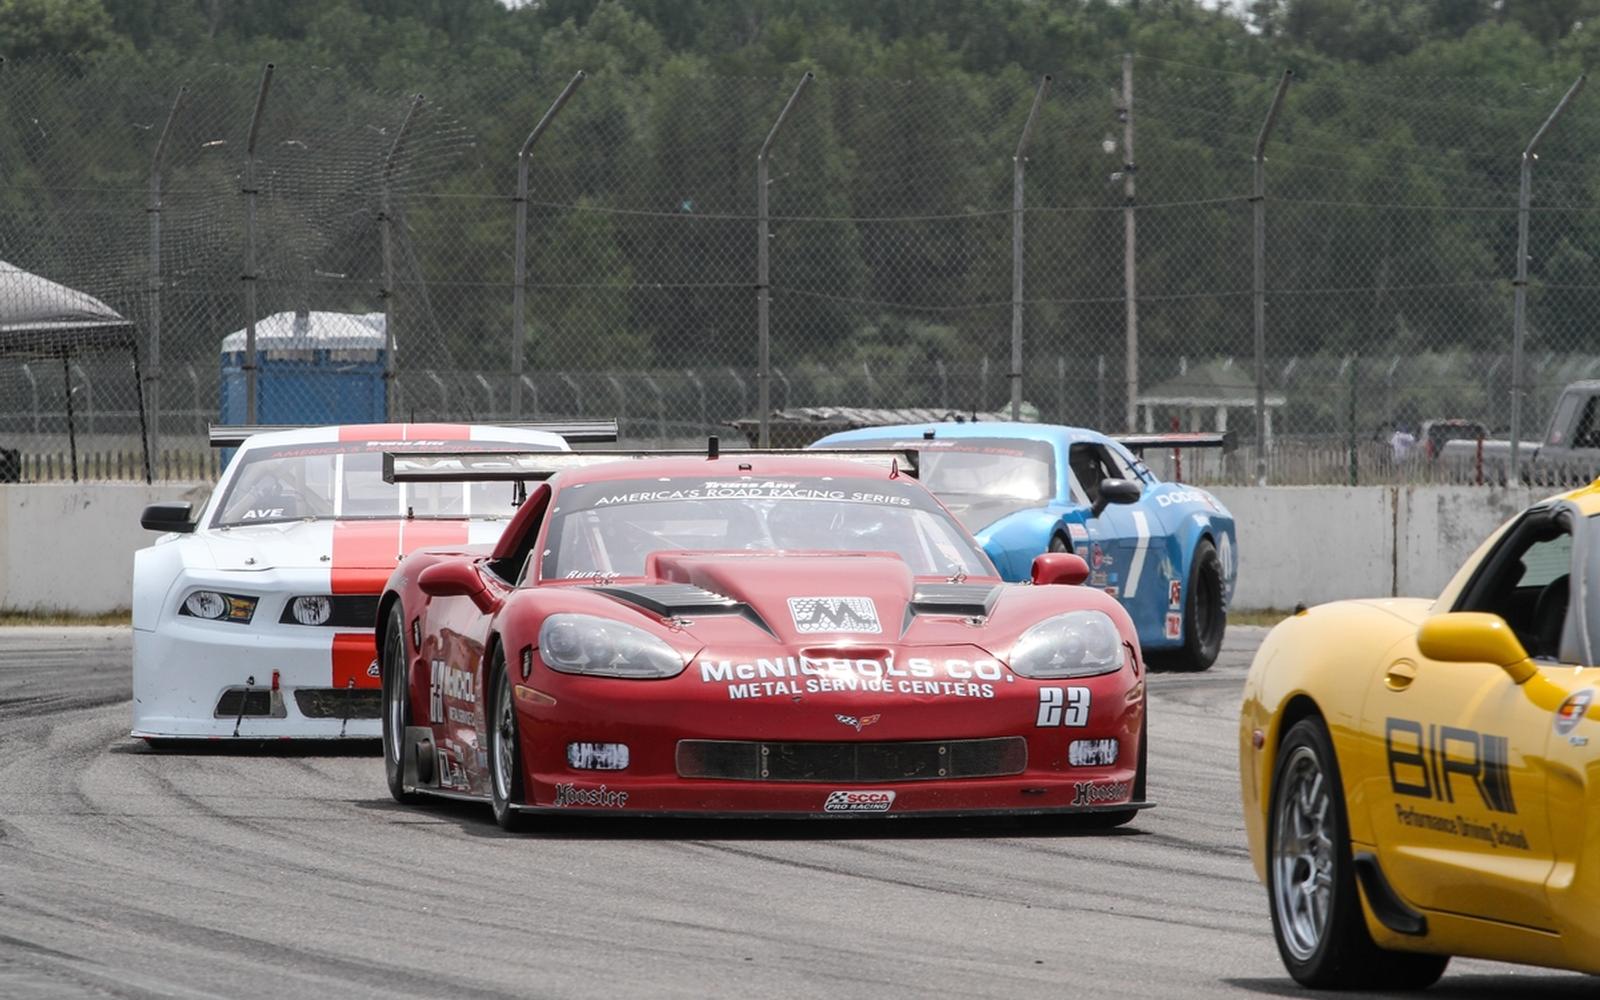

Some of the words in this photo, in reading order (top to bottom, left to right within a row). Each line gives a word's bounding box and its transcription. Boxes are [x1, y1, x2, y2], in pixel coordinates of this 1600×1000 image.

[704, 481, 759, 489] Trans
[760, 481, 797, 489] Am
[594, 489, 700, 506] AMERICA'S
[706, 488, 762, 497] ROAD
[769, 488, 845, 500] RACING
[851, 491, 911, 506] SERIES
[242, 507, 285, 519] AVE
[699, 655, 934, 683] McNICHOLS
[944, 658, 1014, 683] CO.
[728, 680, 802, 699] METAL
[806, 678, 895, 693] SERVICE
[898, 680, 995, 698] CENTERS
[1036, 686, 1091, 728] 23
[553, 782, 630, 808] Hoosier
[847, 793, 889, 803] SCCA
